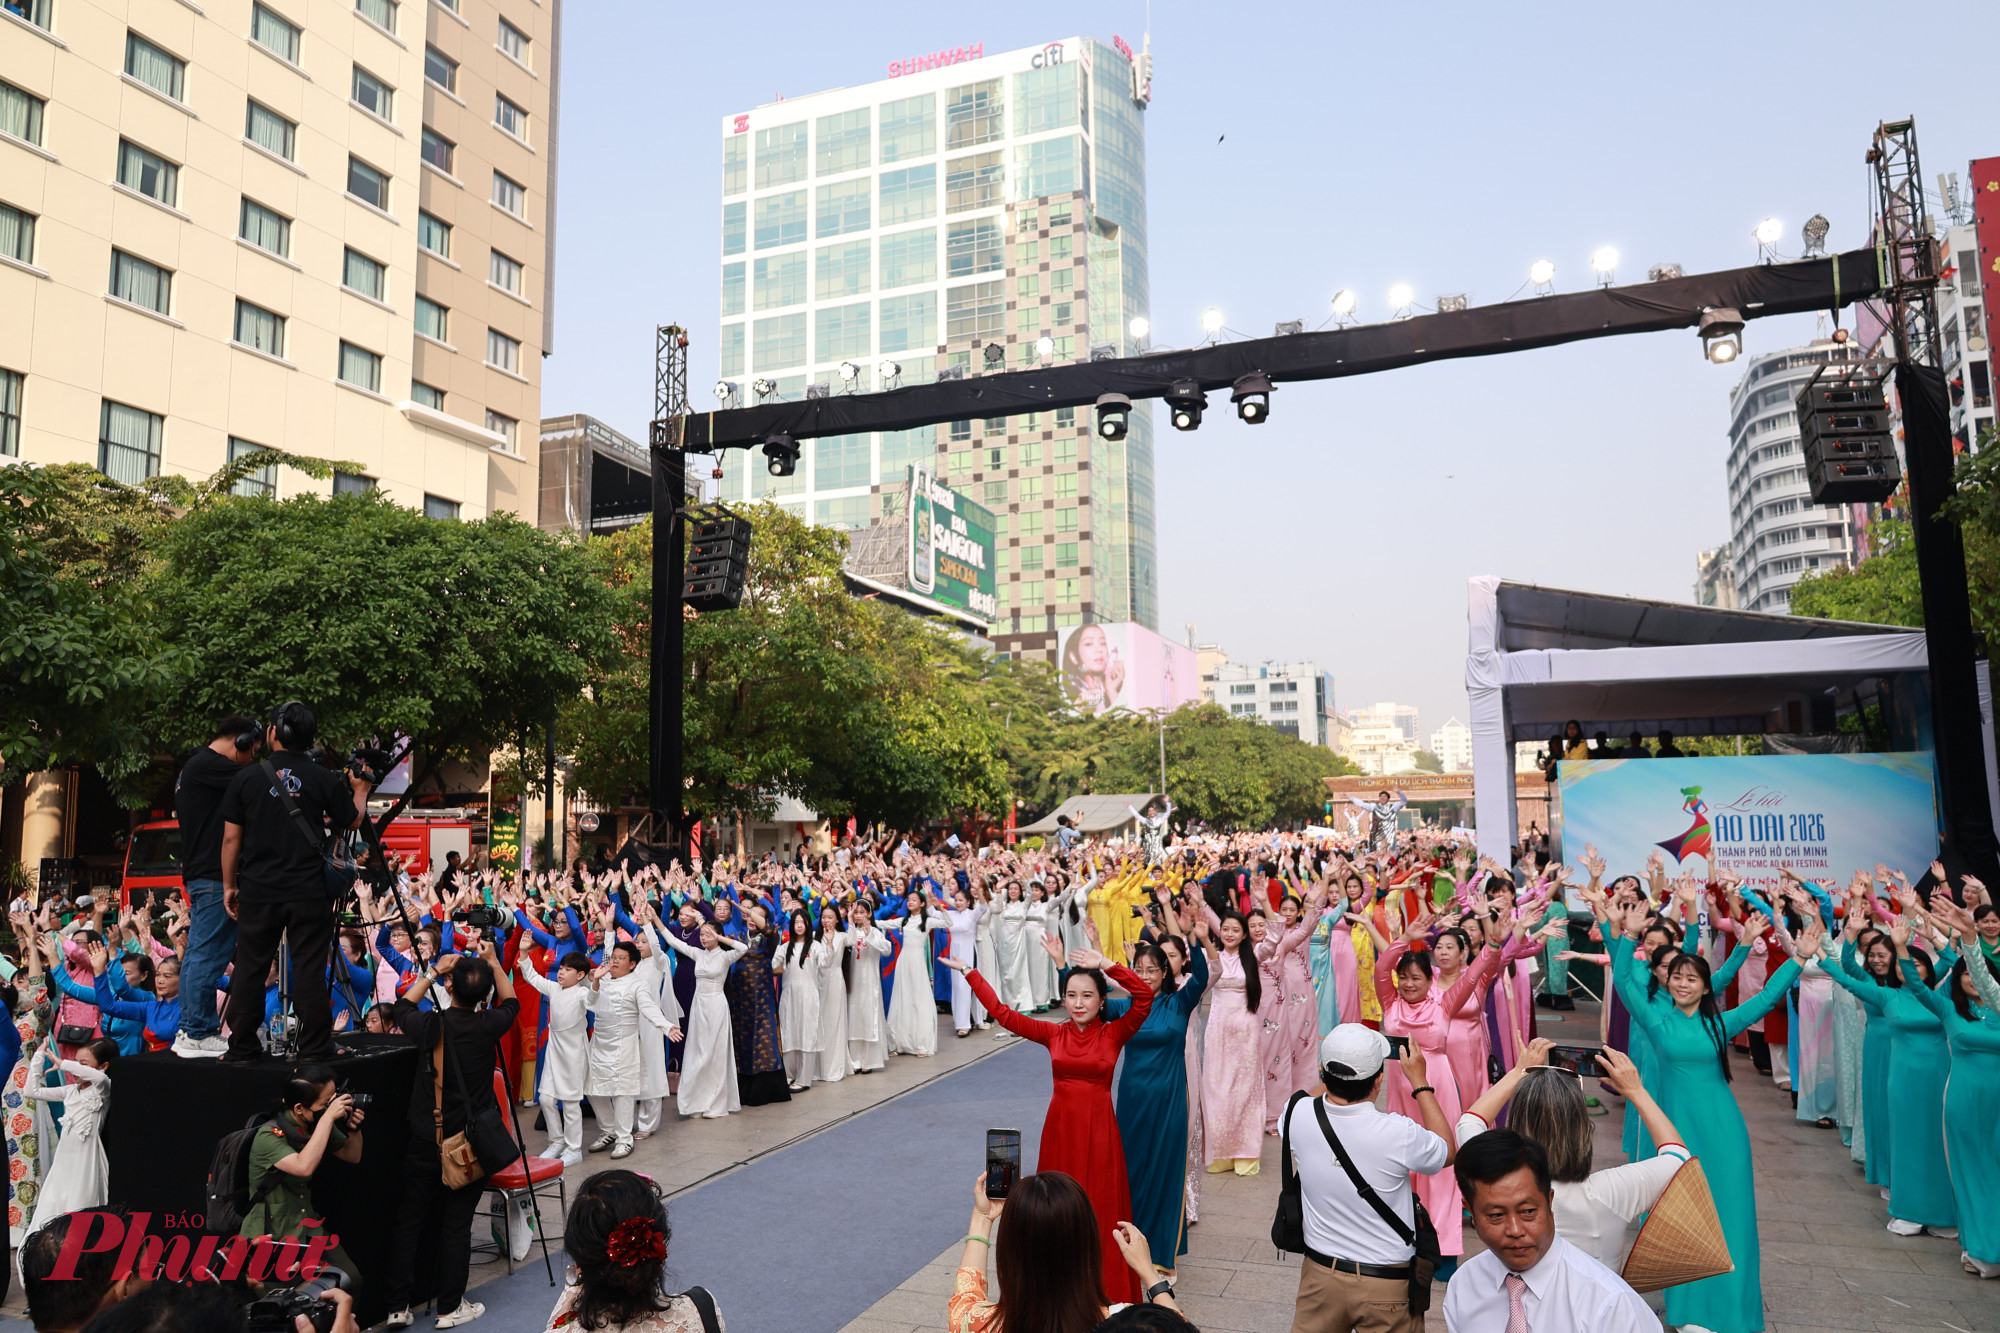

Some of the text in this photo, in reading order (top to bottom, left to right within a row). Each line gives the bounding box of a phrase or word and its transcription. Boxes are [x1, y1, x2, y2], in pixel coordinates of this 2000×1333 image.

[887, 42, 984, 79] SUNWAH
[1031, 41, 1064, 69] citi
[951, 514, 968, 537] BIA
[1714, 785, 1787, 812] Lễ hội
[1715, 811, 1825, 842] ÁO DÀI 2026
[491, 841, 519, 857] 2026
[1717, 843, 1828, 857] THÀNH PHỐ HỒ CHÍ MINH
[1718, 859, 1731, 868] THE
[1747, 859, 1768, 868] HCMC
[1770, 859, 1779, 868] AO
[1796, 859, 1829, 868] FESTIVAL
